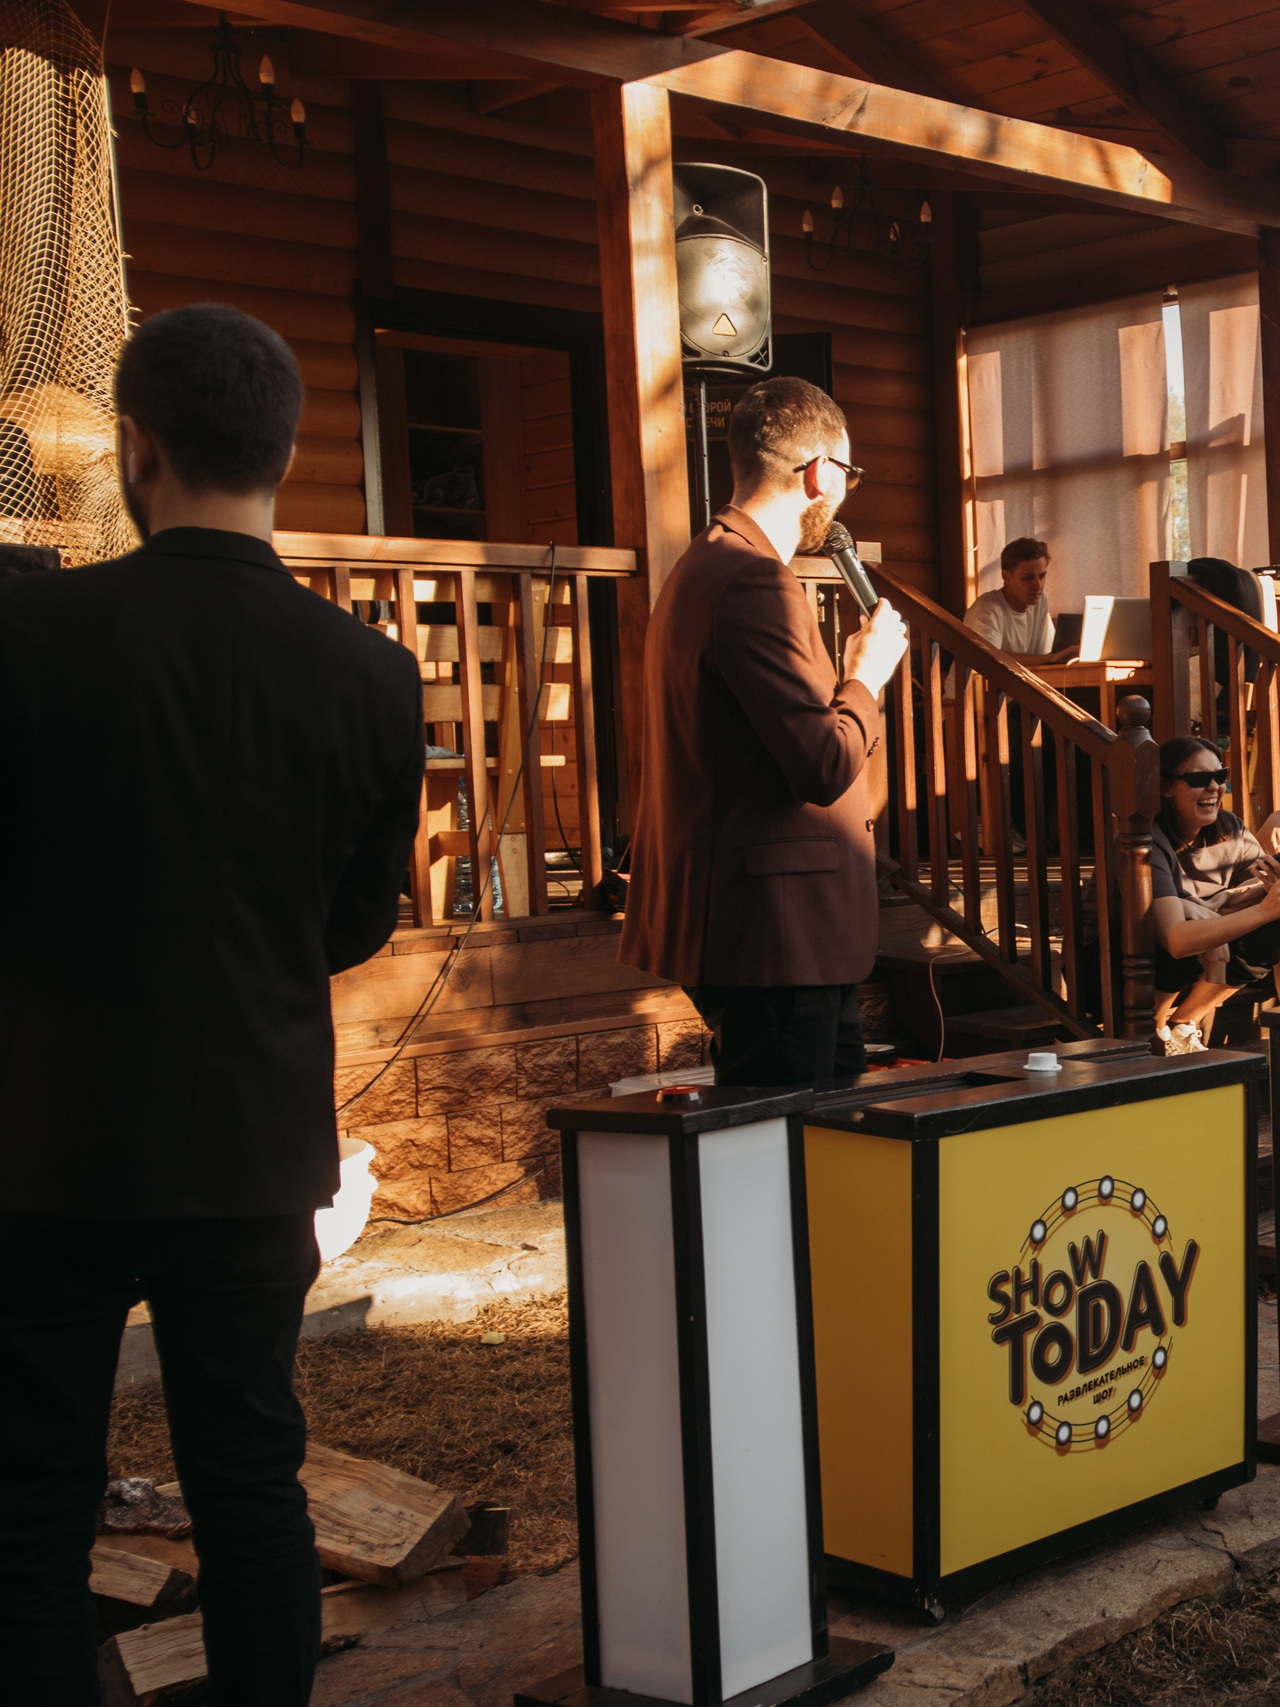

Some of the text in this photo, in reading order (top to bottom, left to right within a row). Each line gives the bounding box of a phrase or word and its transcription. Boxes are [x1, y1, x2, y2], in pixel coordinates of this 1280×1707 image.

[987, 1229, 1106, 1325] SHOW
[991, 1238, 1198, 1406] TODAY
[1057, 1355, 1146, 1406] РАЗВЛЕКАТЕЛЬНОЕ
[1092, 1386, 1114, 1405] ШОУ
